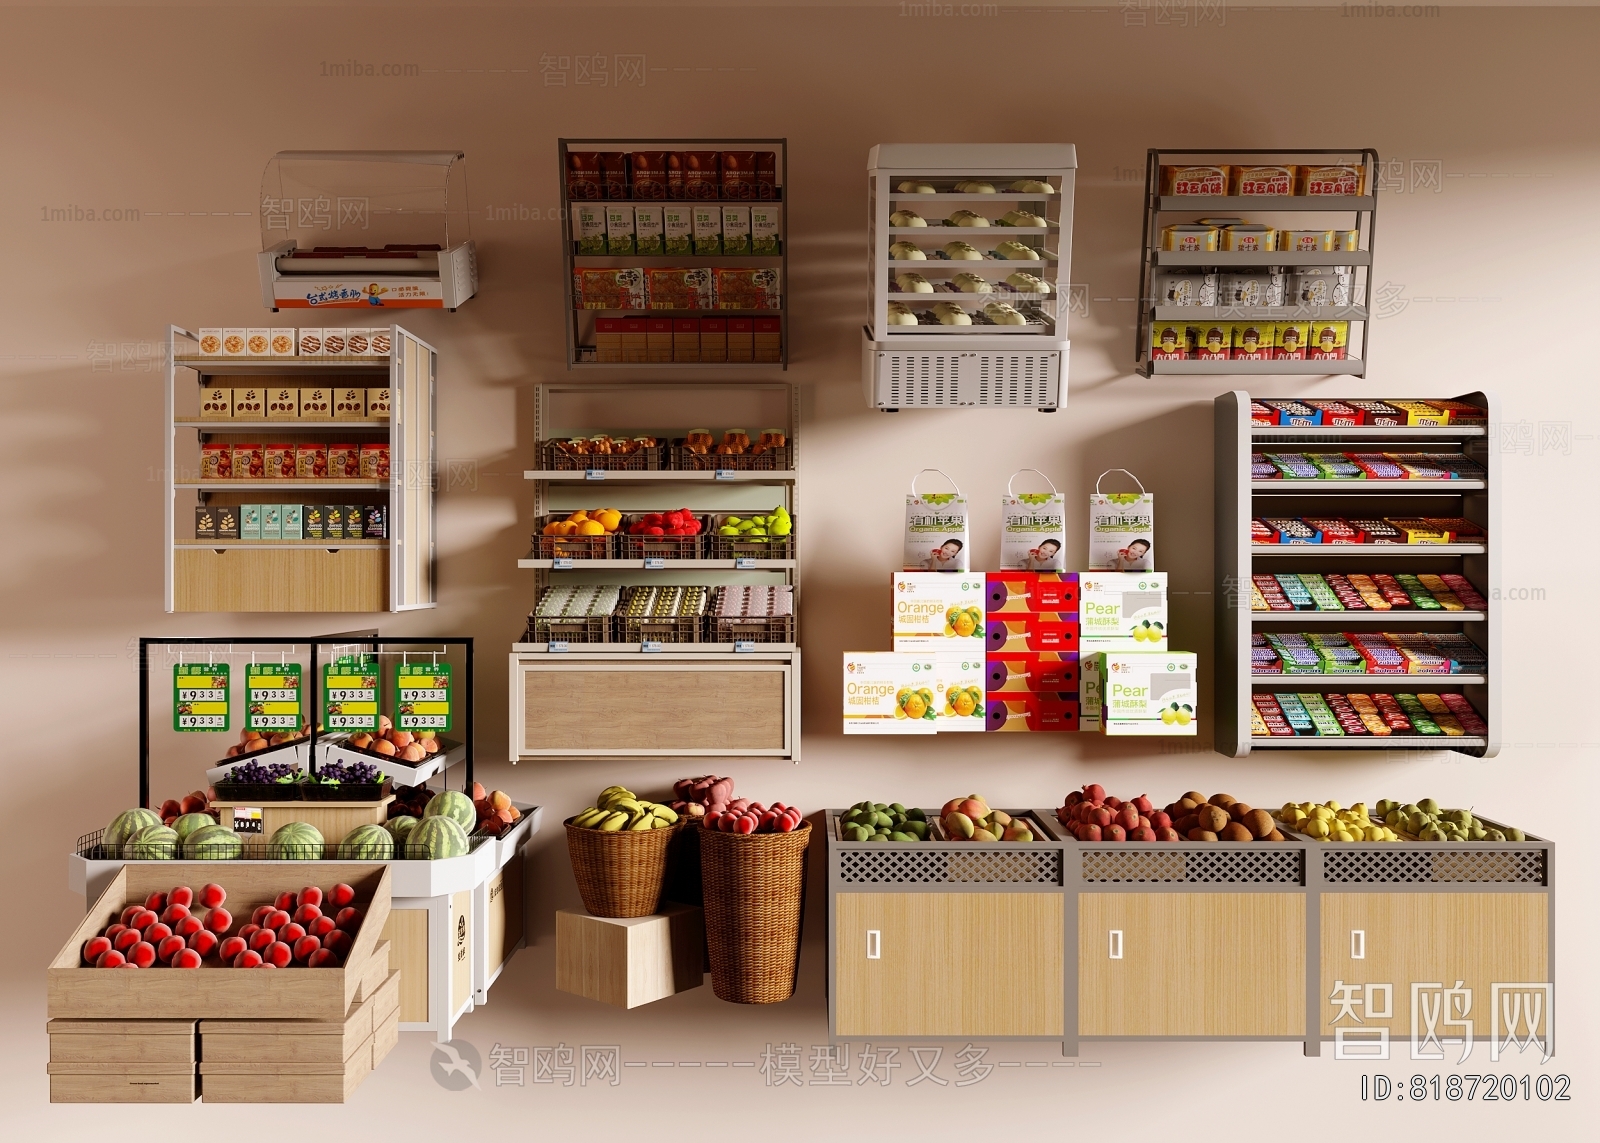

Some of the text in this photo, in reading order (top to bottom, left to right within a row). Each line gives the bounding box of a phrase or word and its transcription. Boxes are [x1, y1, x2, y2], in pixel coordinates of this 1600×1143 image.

[897, 601, 945, 616] Orange
[1085, 602, 1121, 615] Pear
[847, 682, 895, 697] Orange
[1112, 684, 1149, 697] Pear
